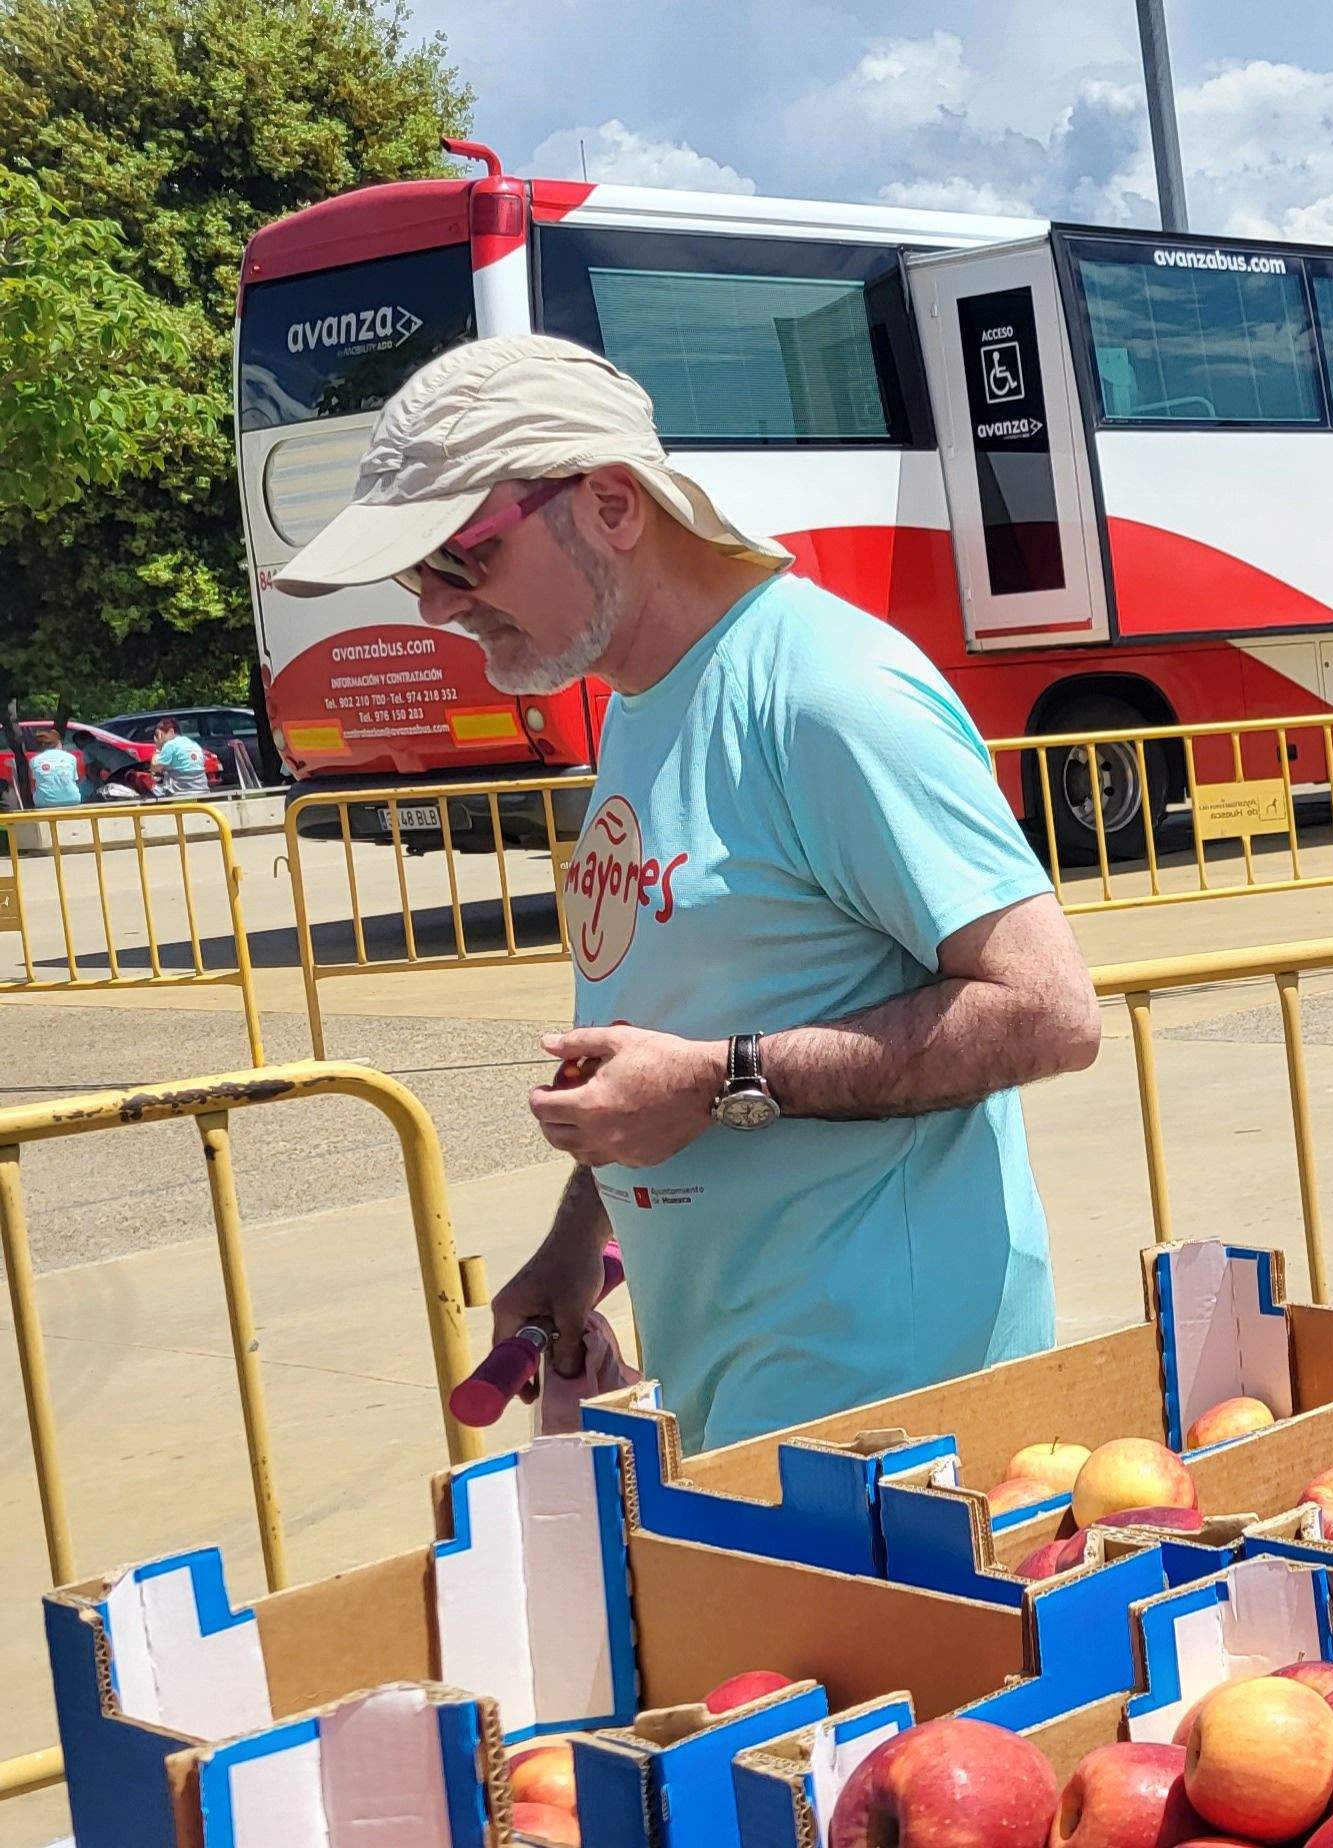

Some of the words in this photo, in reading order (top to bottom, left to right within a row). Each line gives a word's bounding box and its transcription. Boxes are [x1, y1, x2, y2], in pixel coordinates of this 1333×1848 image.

[1153, 249, 1286, 274] avanzabus.com
[287, 306, 393, 353] avanza
[982, 326, 1014, 342] ACCESO
[978, 418, 1029, 438] avanza
[332, 637, 436, 662] avanzabus.com
[331, 673, 380, 690] INFORMACIÓN
[386, 668, 443, 685] CONTRATACIÓN
[325, 698, 337, 709] Tel.
[339, 696, 354, 709] 902
[355, 695, 370, 707] 210
[406, 691, 422, 703] 974
[424, 689, 440, 701] 218
[441, 688, 458, 700] 352
[358, 711, 373, 723] Tel.
[374, 710, 390, 721] 976
[392, 708, 407, 720] 150
[409, 707, 424, 719] 283
[416, 809, 438, 826] BLB
[565, 852, 688, 935] mayores
